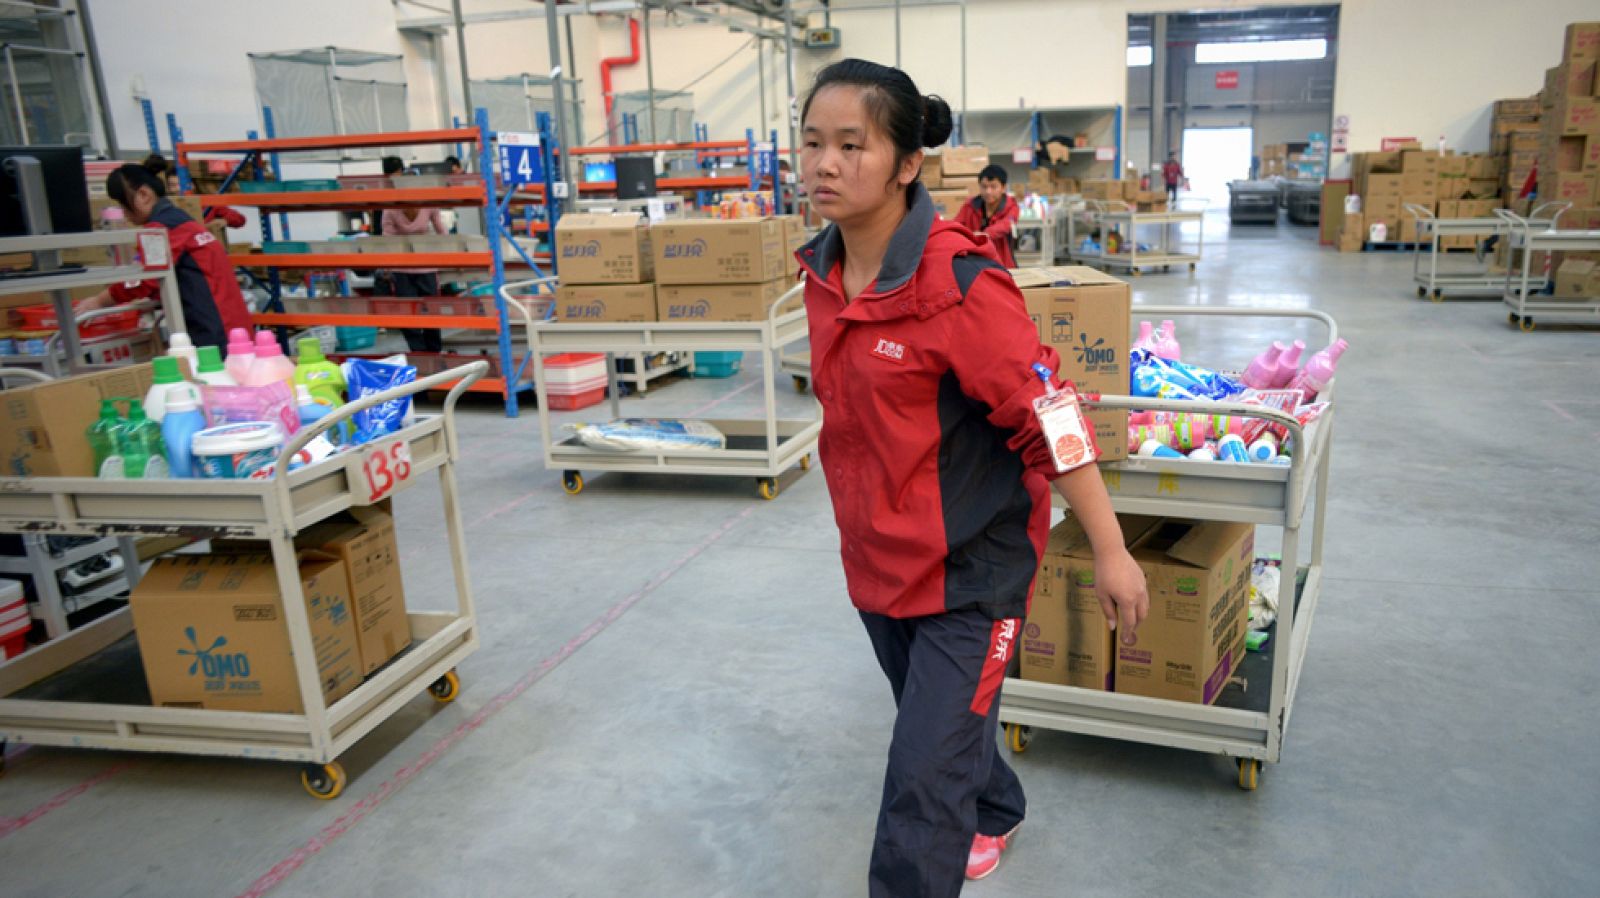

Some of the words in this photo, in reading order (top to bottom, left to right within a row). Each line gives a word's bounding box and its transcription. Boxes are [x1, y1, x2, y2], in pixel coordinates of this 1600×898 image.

[518, 148, 533, 182] 4
[1085, 349, 1115, 365] OMO
[202, 652, 250, 680] OMO
